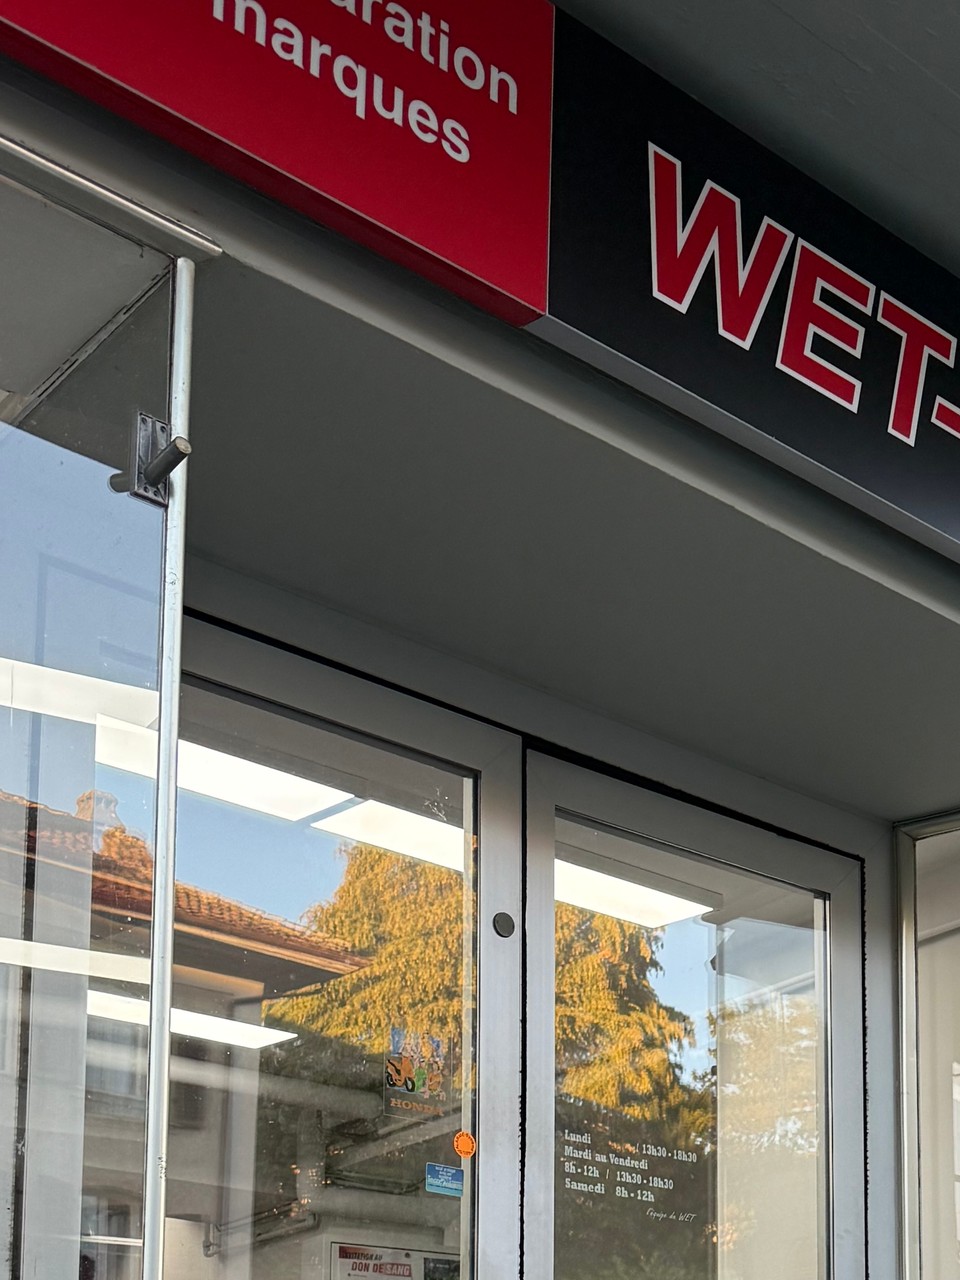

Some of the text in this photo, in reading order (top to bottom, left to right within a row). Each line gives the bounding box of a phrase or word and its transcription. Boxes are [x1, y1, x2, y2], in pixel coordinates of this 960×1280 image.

[212, 0, 471, 163] marques
[564, 1129, 591, 1144] Lundi
[642, 1144, 667, 1158] 13h30
[673, 1149, 698, 1163] 18h30
[564, 1145, 649, 1170] Mardi au Vendredi
[564, 1161, 577, 1174] 8h
[583, 1165, 600, 1178] 12h
[616, 1171, 642, 1185] 13h30
[648, 1175, 674, 1190] 18h30
[565, 1178, 606, 1195] Samedi
[615, 1186, 629, 1198] 8h
[636, 1189, 655, 1202] 12h
[351, 1261, 411, 1277] DON DE SANG
